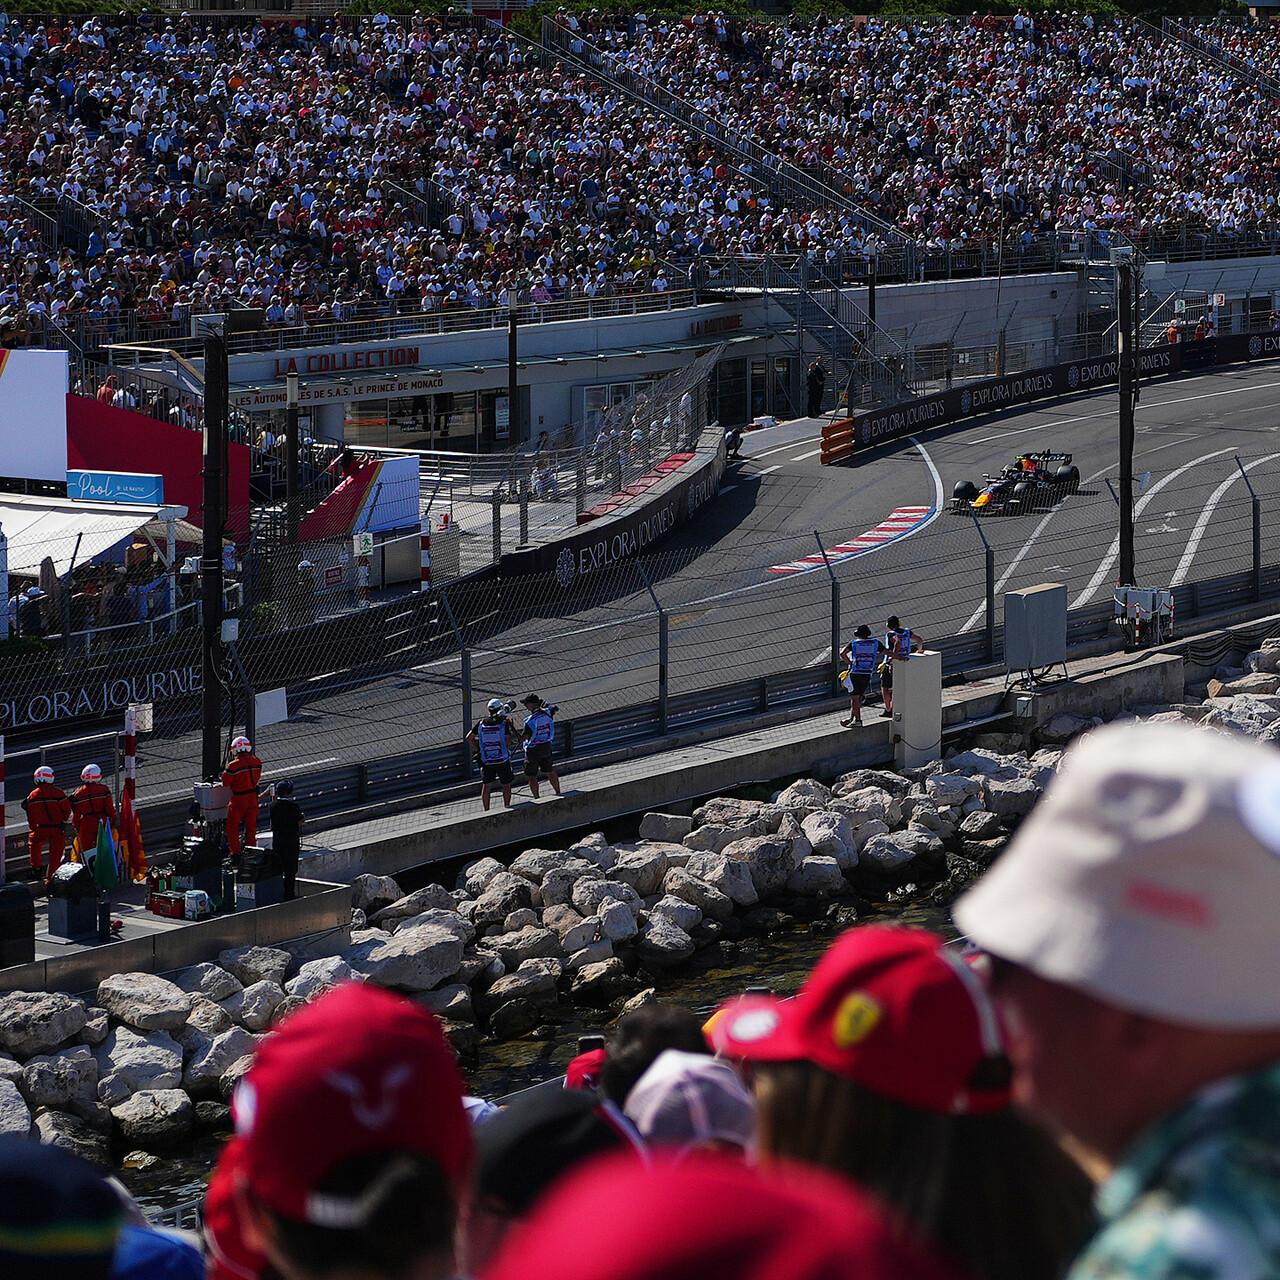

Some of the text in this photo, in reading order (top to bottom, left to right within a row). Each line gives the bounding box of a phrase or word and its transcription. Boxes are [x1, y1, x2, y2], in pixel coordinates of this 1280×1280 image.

[276, 347, 420, 376] LA COLLECTION
[235, 378, 444, 407] LES AUTOMOES DE S.A.S. LE PRINCE DE MONACO
[972, 373, 1053, 407] EXPLORA JOURNEYS
[871, 400, 945, 437] EXPLORA JOURNEYS
[78, 472, 113, 498] Pool
[579, 502, 676, 575] EXPLORA JOURNEYS
[100, 658, 233, 717] JOURNES
